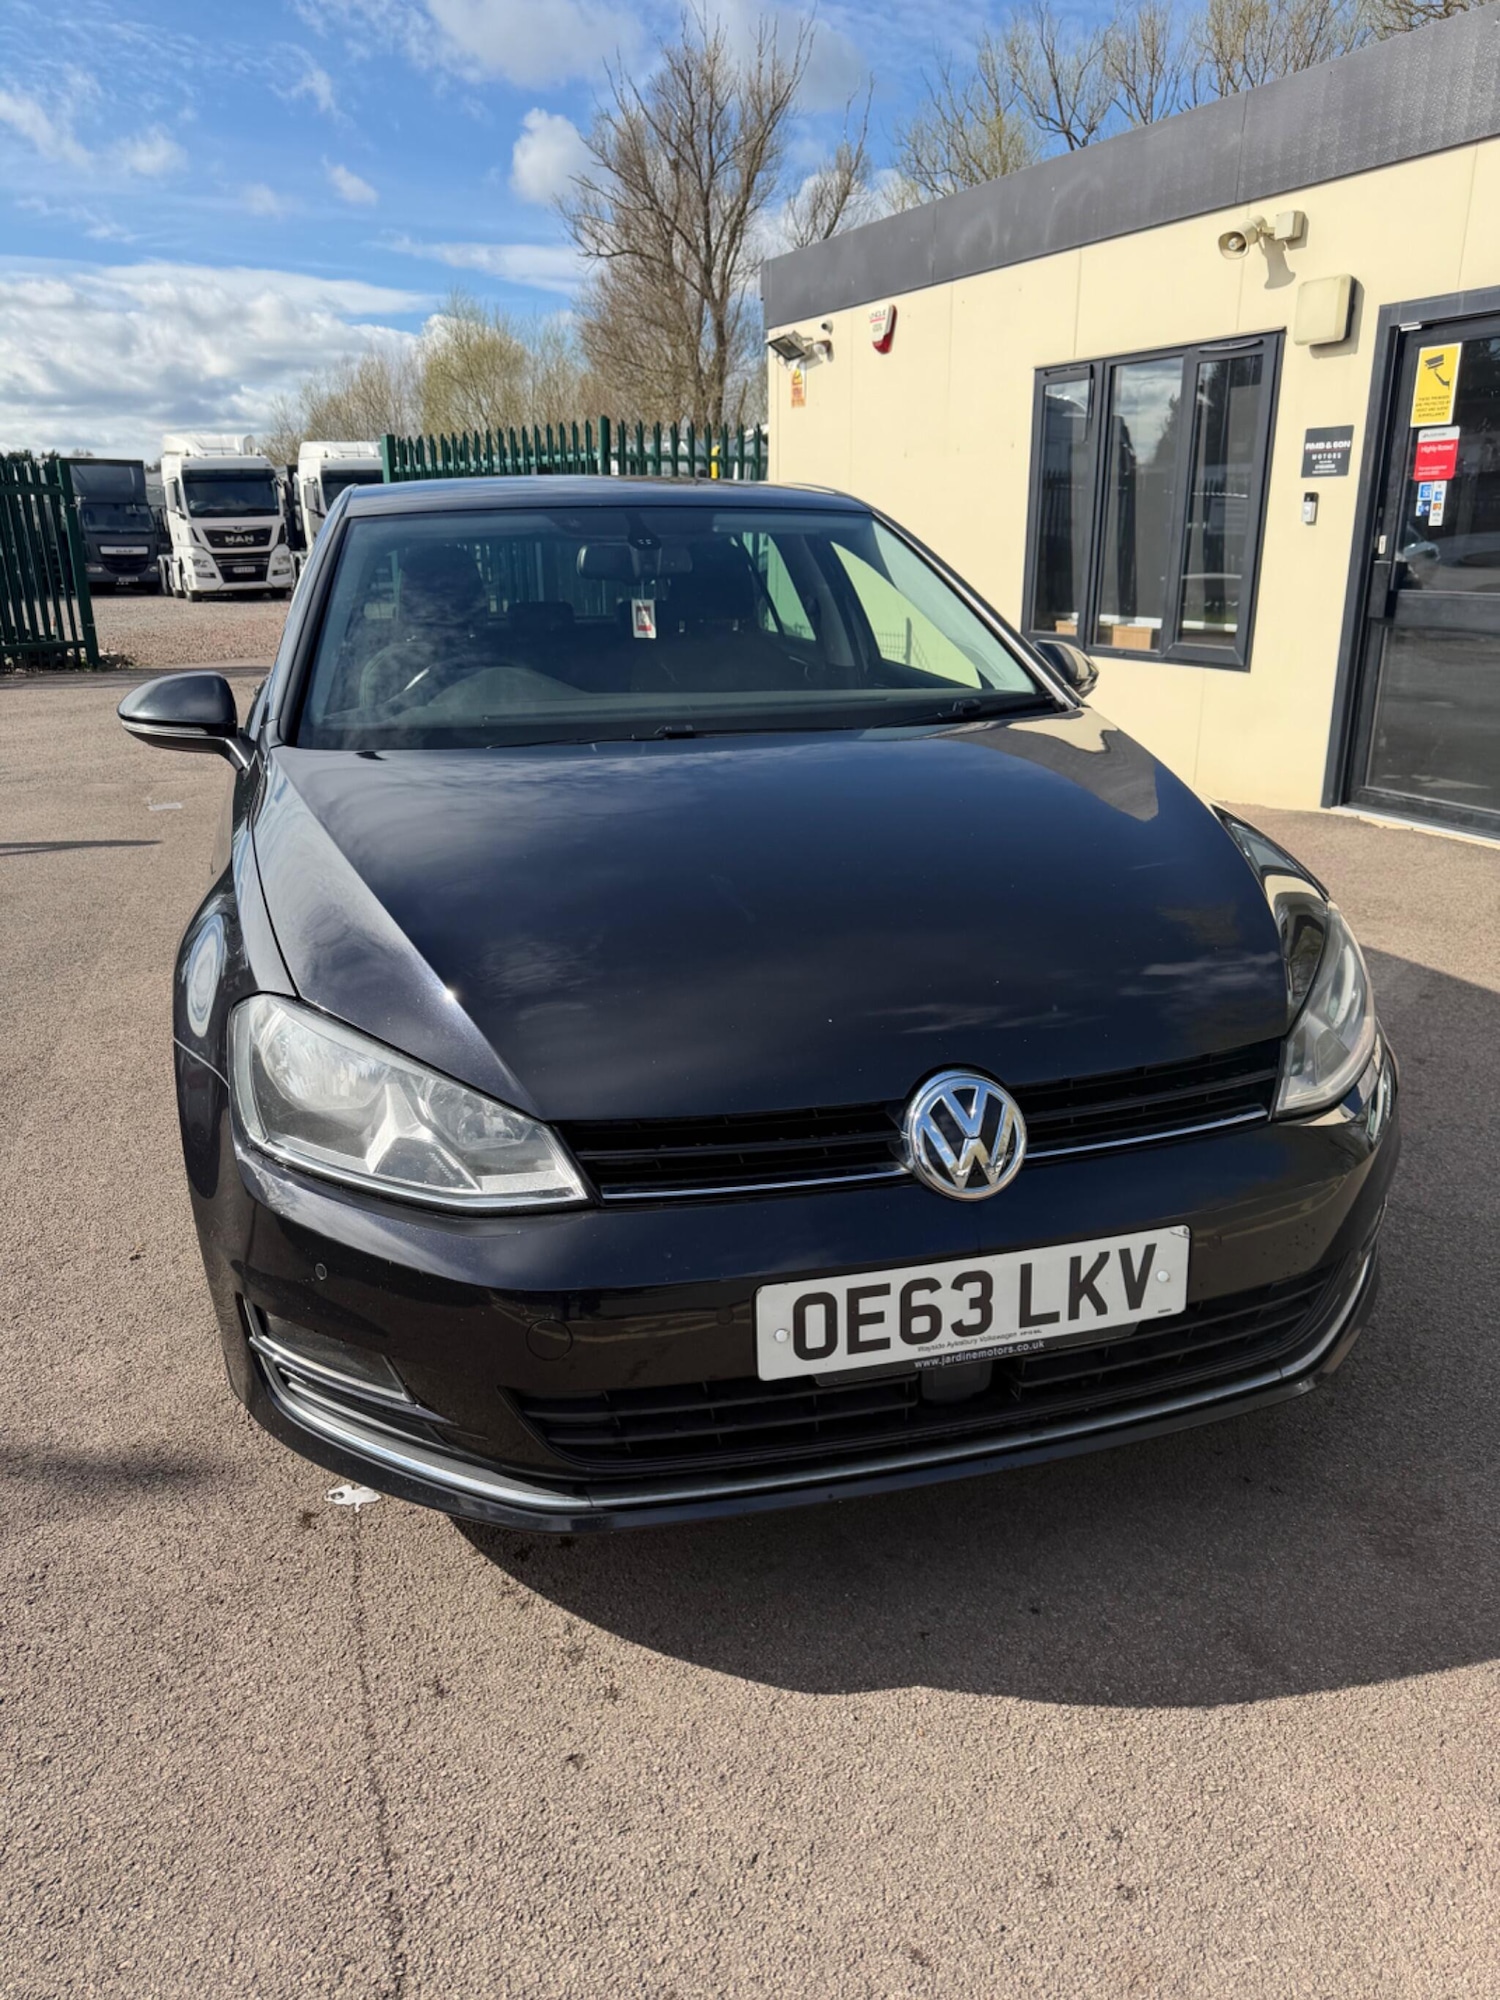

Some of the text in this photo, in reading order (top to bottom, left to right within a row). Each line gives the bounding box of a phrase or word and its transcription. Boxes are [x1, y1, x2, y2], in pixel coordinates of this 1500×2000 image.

[1312, 452, 1341, 460] MOTORS
[225, 535, 254, 543] MAN
[793, 1243, 1158, 1361] OE63 LKV
[947, 1337, 978, 1349] Aylesbury
[914, 1339, 1045, 1368] www.jardinemotors.co.uk
